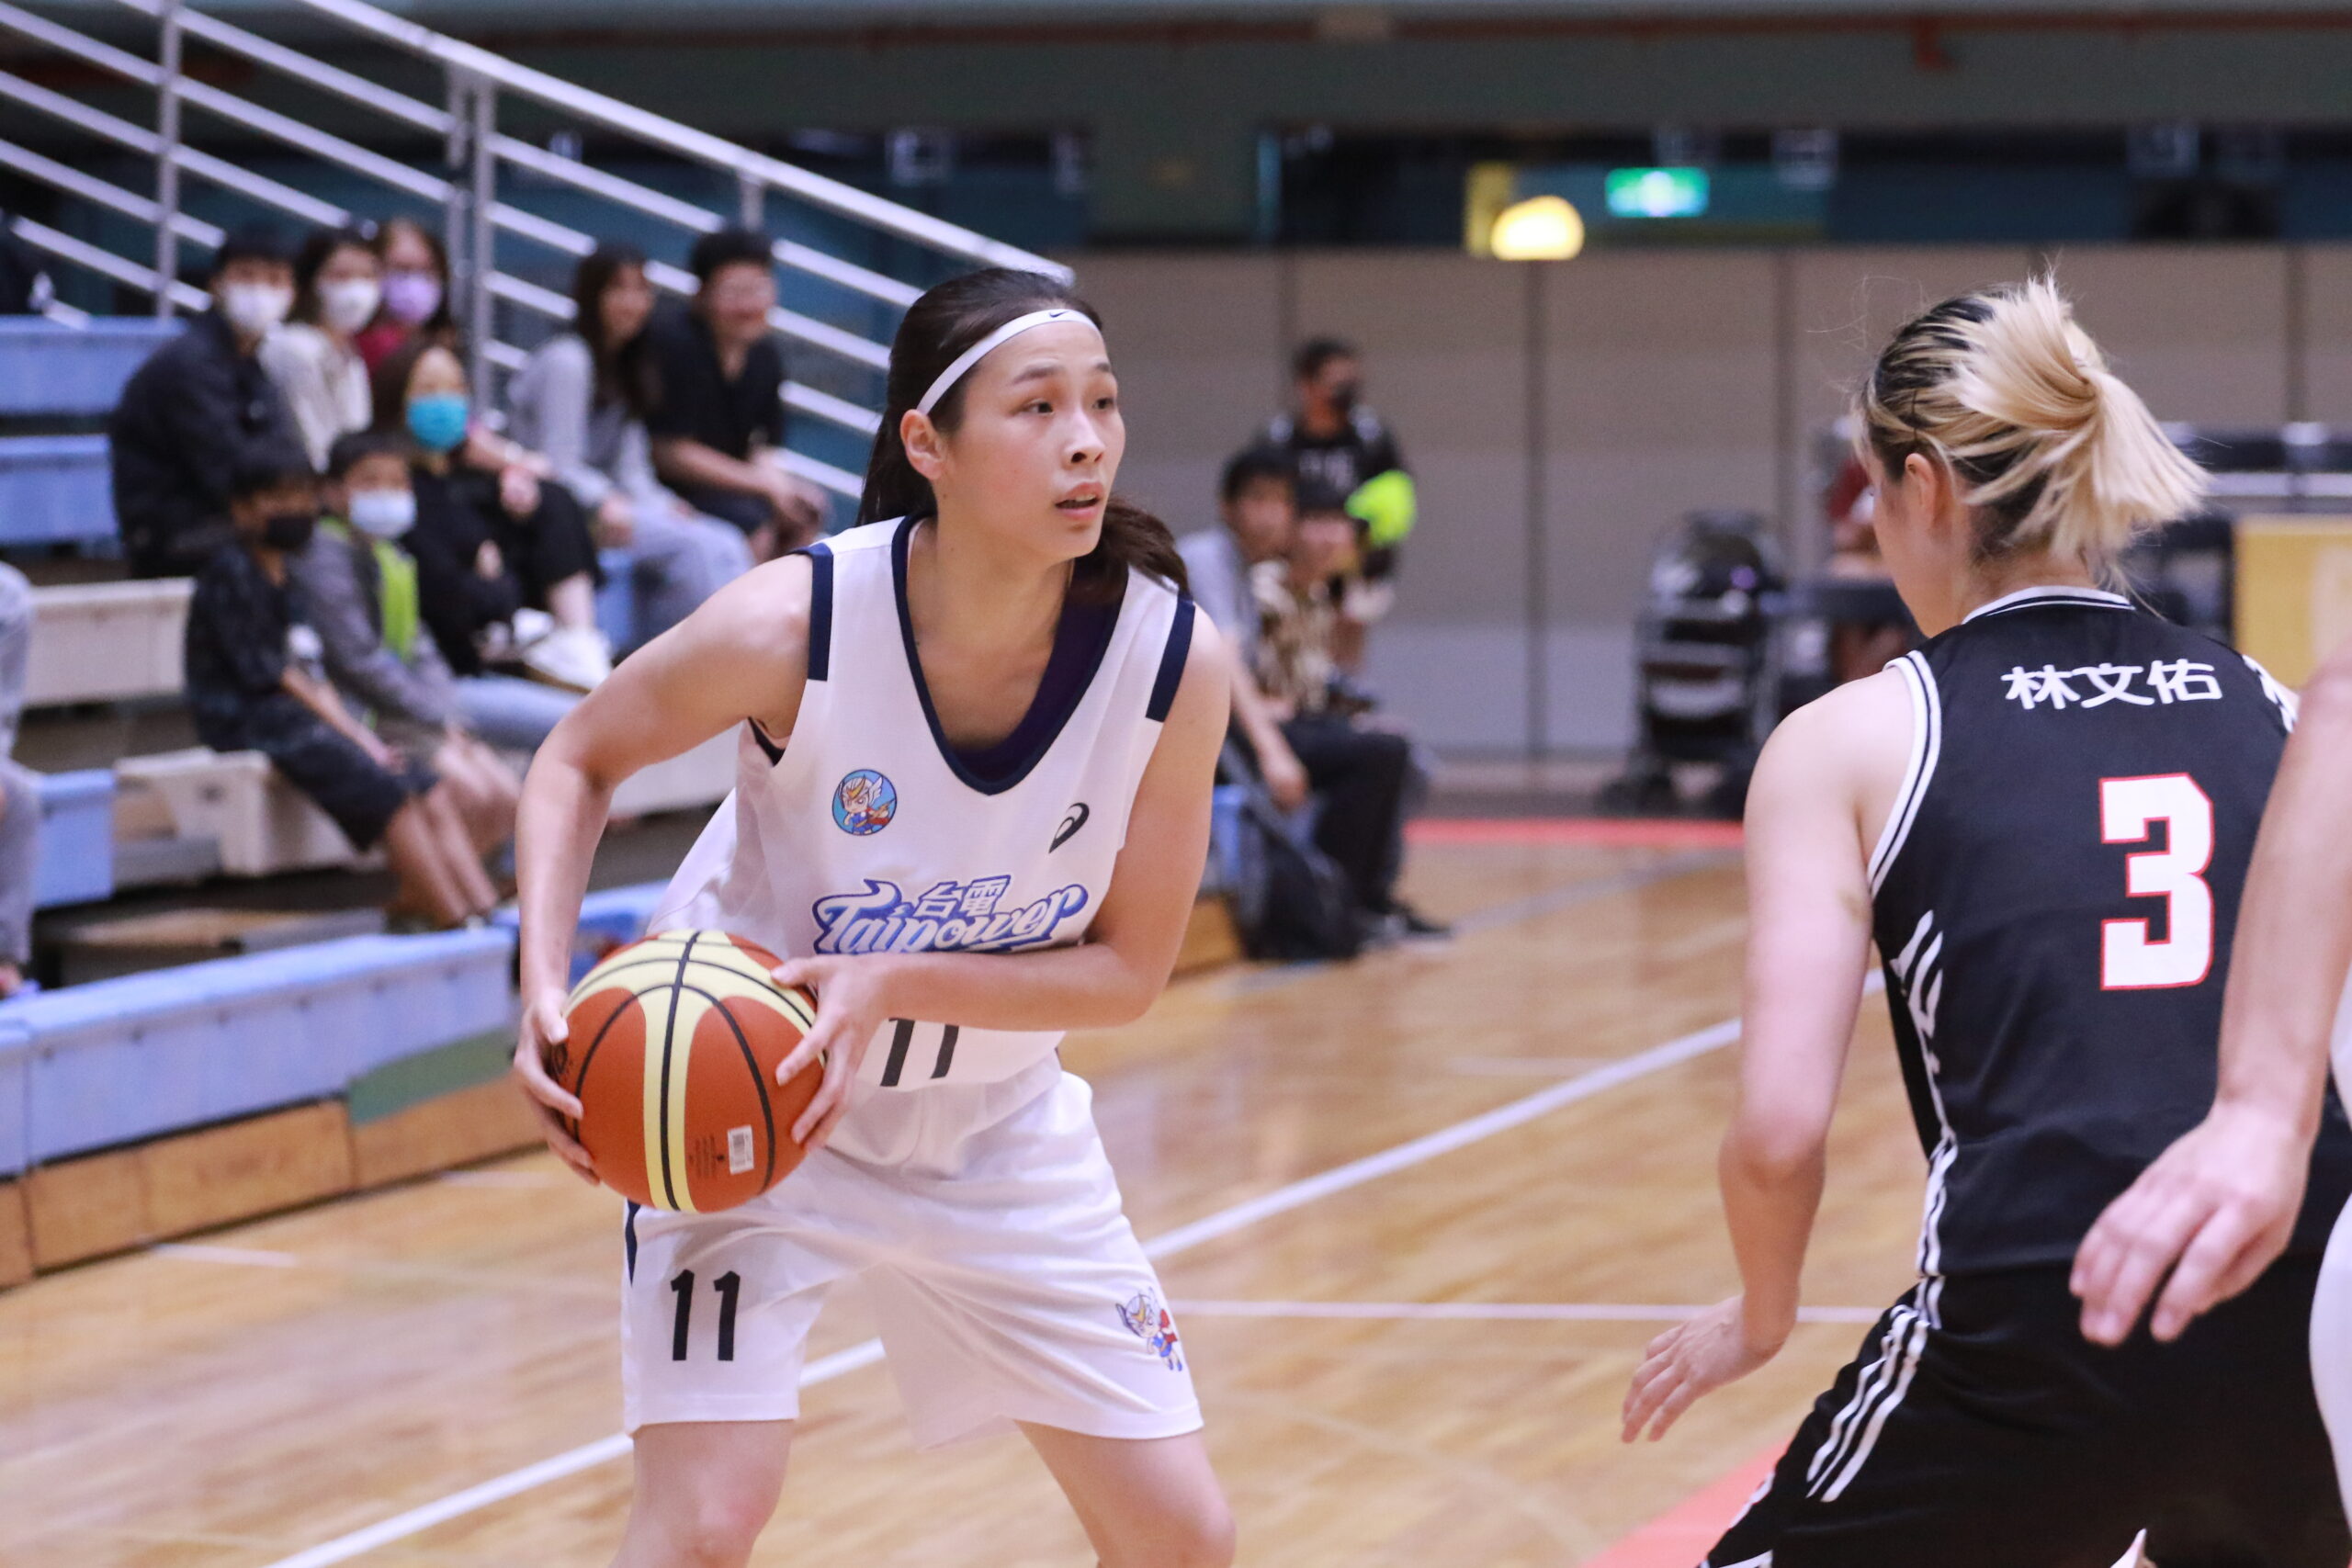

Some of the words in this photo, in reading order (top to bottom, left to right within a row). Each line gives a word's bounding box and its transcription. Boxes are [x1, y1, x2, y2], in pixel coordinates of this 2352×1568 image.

[2001, 659, 2222, 710] 林文佑
[812, 878, 1089, 955] Taipower
[915, 875, 1010, 918] 台電
[2098, 772, 2214, 991] 3
[670, 1269, 741, 1361] 11
